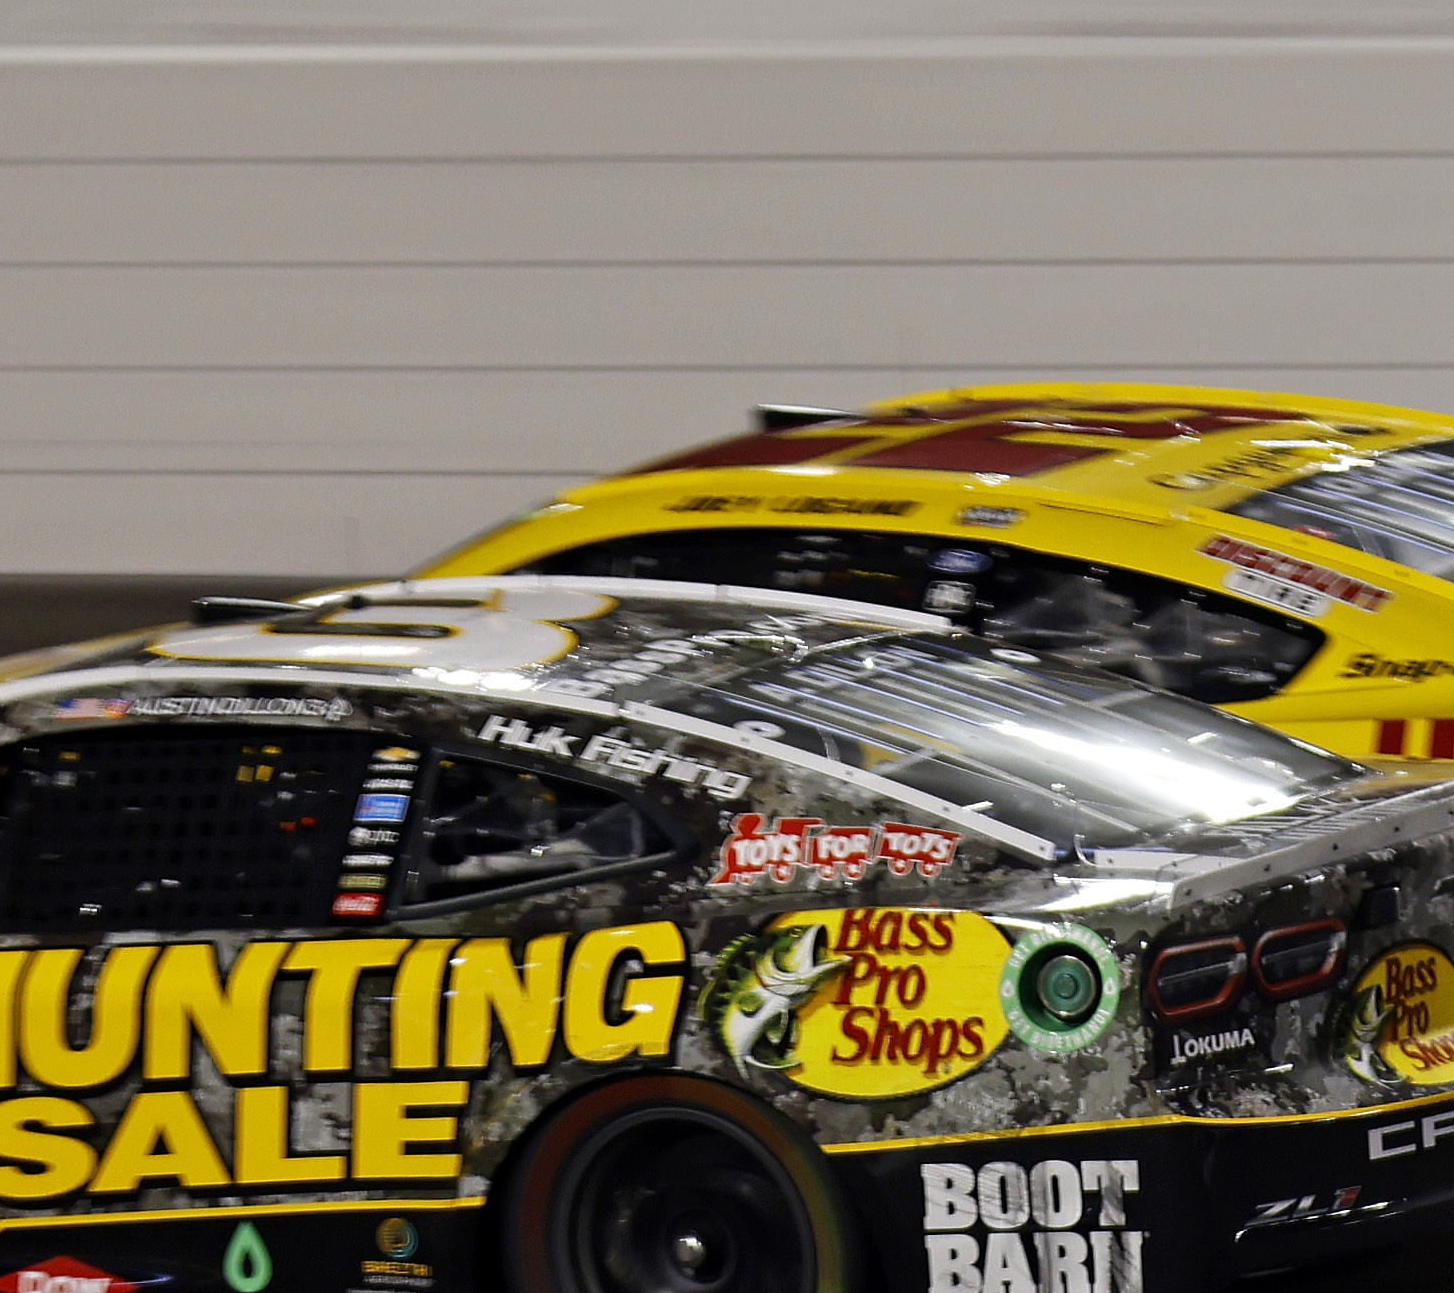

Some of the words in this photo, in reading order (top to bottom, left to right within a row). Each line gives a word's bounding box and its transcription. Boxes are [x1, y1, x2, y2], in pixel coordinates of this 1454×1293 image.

[479, 714, 581, 757] Huk
[580, 733, 754, 799] Fishing
[734, 834, 802, 867] TOYS
[817, 832, 871, 861] FOR
[884, 829, 954, 863] TOTS
[833, 907, 956, 953] Bass
[831, 952, 926, 1007] Pro
[1384, 955, 1439, 1005] Bass
[831, 1006, 986, 1079] Shops
[1390, 997, 1432, 1041] Pro
[920, 1160, 1139, 1230] BOOT
[1245, 1185, 1363, 1228] ZL1
